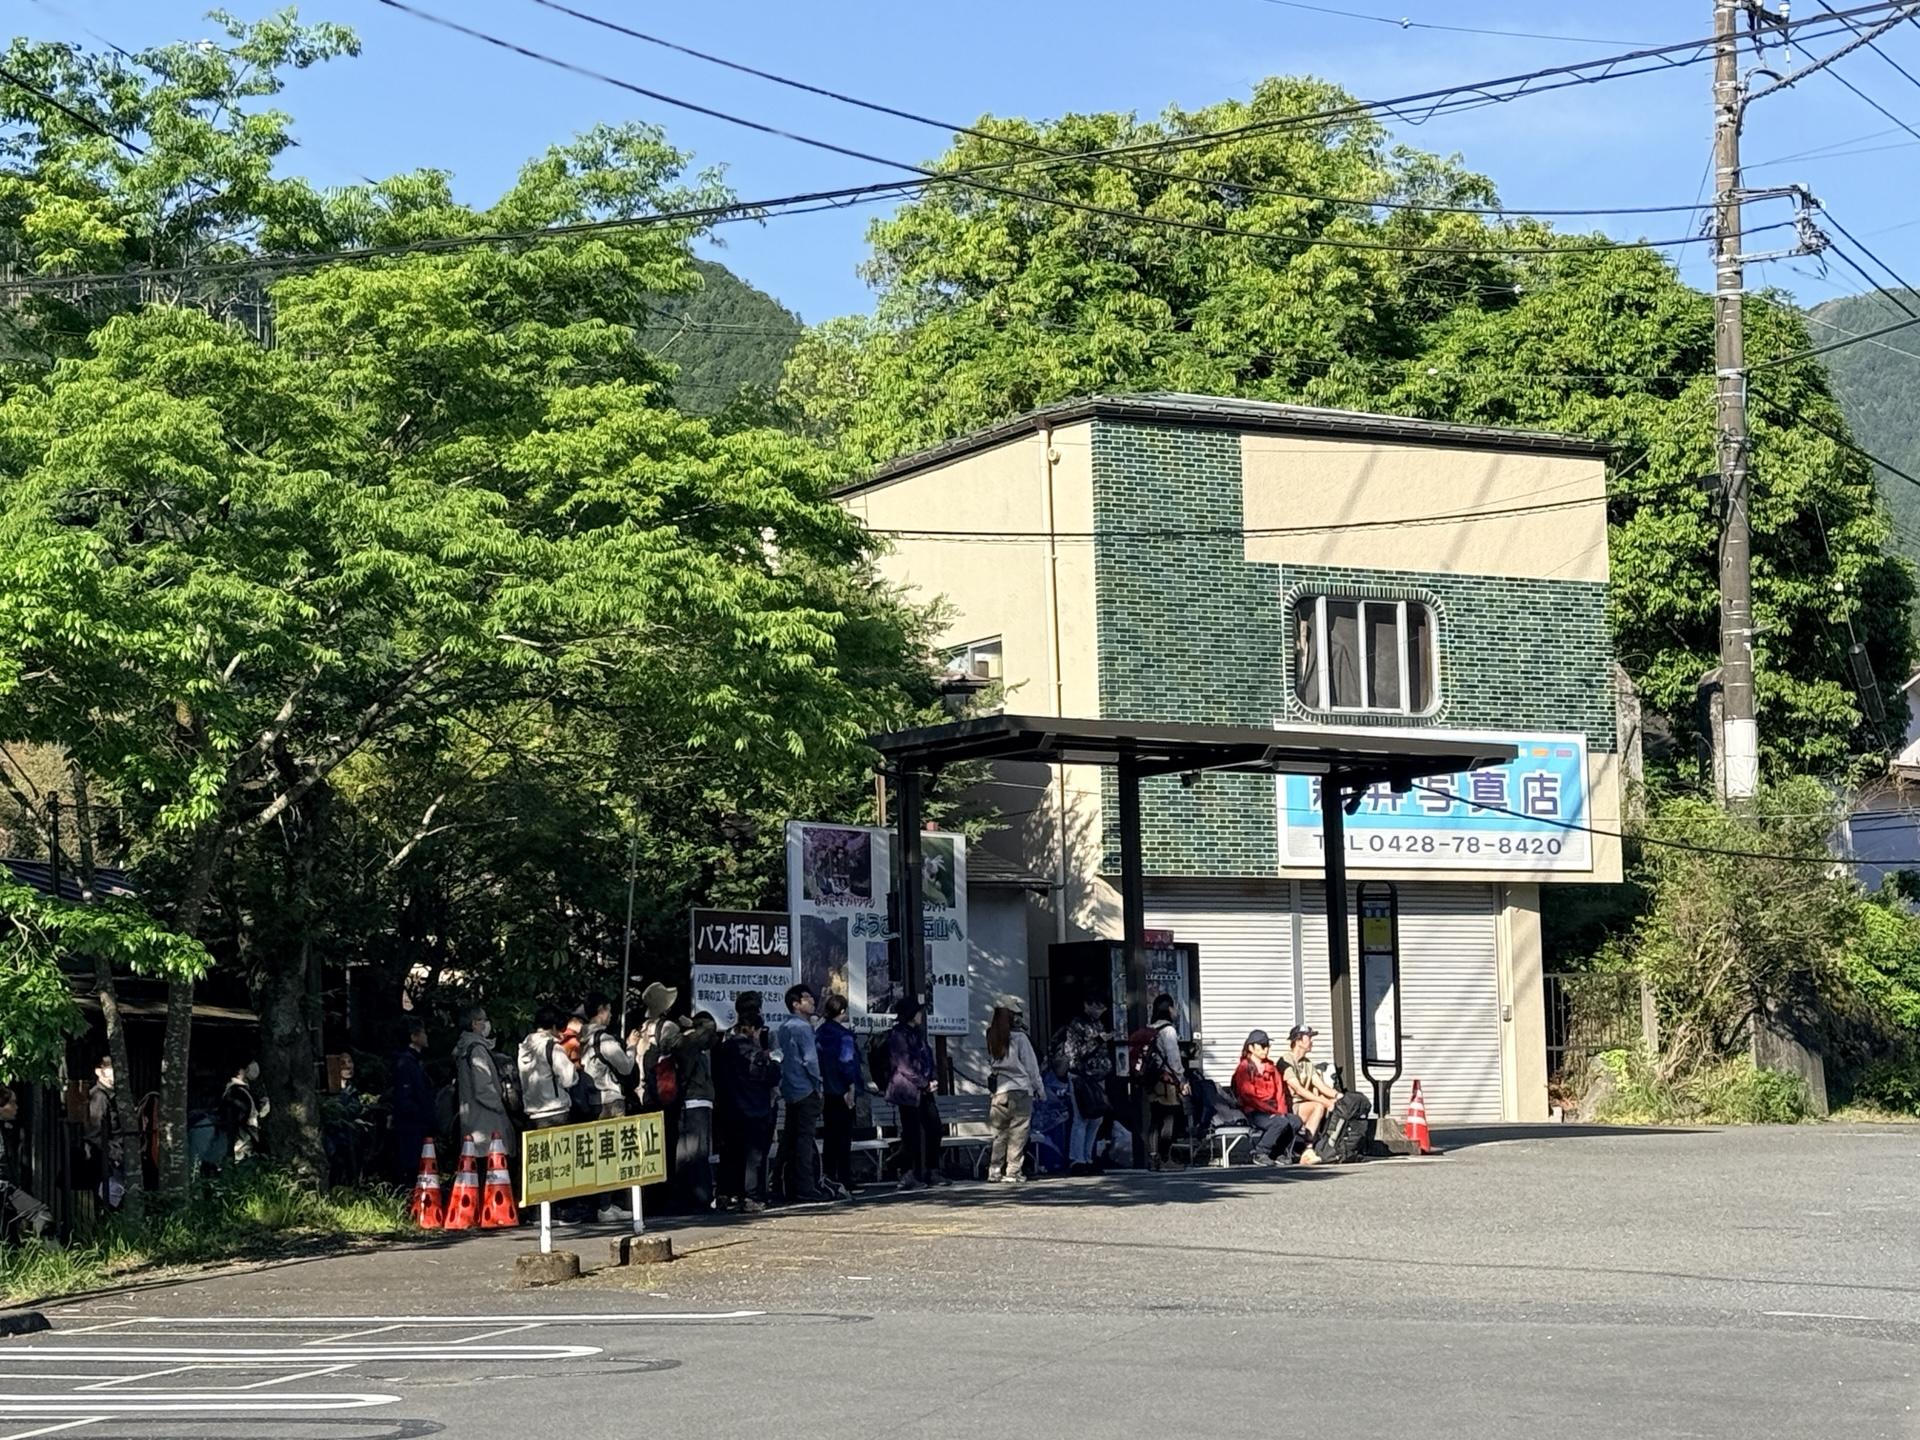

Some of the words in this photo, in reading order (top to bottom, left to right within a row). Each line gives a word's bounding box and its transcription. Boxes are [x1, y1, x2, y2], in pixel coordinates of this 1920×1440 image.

[1313, 834, 1363, 851] TL
[697, 922, 789, 957] バス折返し場
[528, 1137, 571, 1165] 路線バス
[575, 1123, 661, 1170] 駐車禁止
